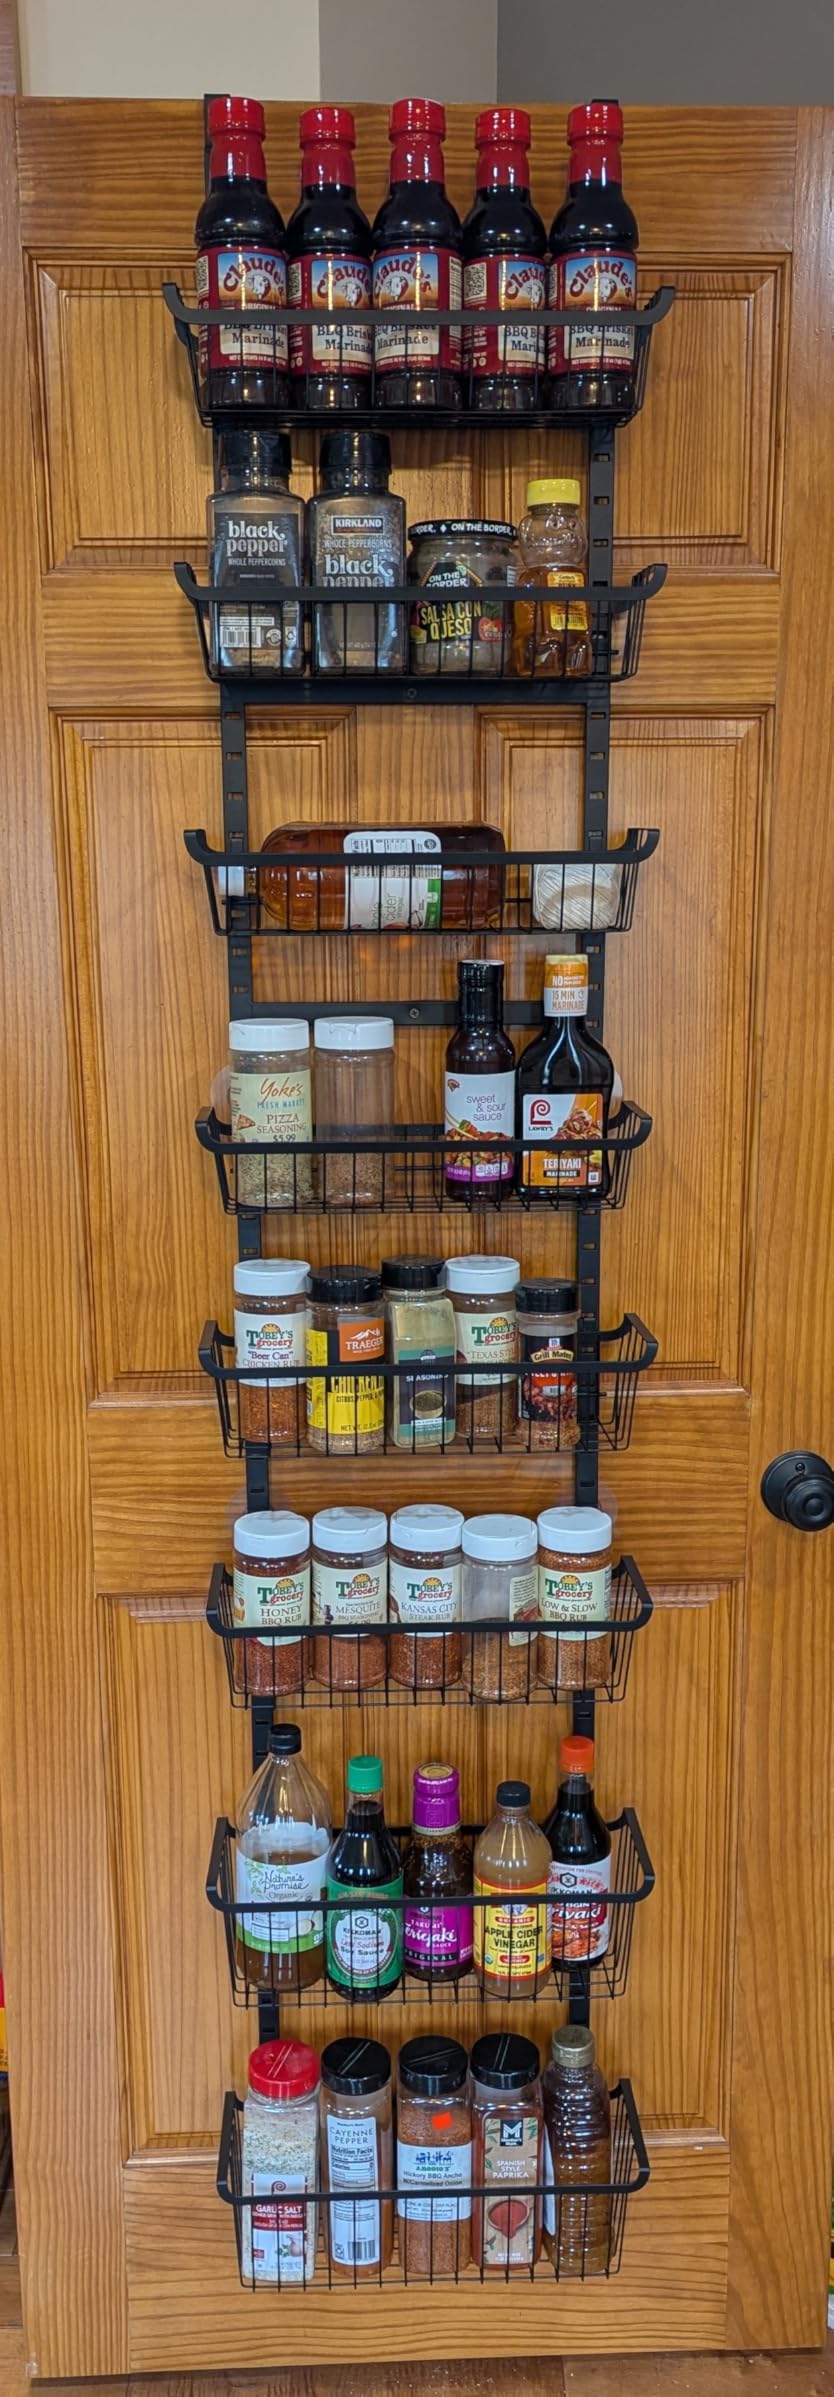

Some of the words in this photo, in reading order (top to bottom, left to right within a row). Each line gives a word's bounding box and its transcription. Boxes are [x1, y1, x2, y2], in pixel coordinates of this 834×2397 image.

[570, 259, 633, 299] Claude's
[335, 518, 382, 528] KIRKLAND
[451, 523, 465, 532] ON
[466, 523, 482, 532] THE
[227, 520, 286, 540] black
[226, 538, 288, 557] pepper
[228, 558, 247, 567] WHOLE
[248, 558, 286, 567] PEPPERCORNS
[324, 554, 394, 577] black
[429, 574, 442, 583] ON
[444, 571, 460, 581] THE
[384, 892, 397, 921] cider
[552, 975, 564, 986] NO
[552, 990, 560, 1000] 15
[560, 990, 575, 1001] MIN
[552, 1001, 585, 1009] MARINADE
[260, 1076, 304, 1104] Yoke's
[256, 1101, 279, 1109] FRESH
[466, 1094, 496, 1104] sweet
[476, 1103, 484, 1113] &
[486, 1102, 507, 1113] sour
[266, 1113, 300, 1125] PIZZA
[472, 1112, 502, 1122] sauce
[256, 1122, 307, 1134] SEASONING
[543, 1158, 582, 1169] TERIYAKI
[246, 1330, 294, 1347] TOBEY'S
[256, 1338, 294, 1350] grocery
[472, 1350, 498, 1360] TEXAS
[534, 1351, 550, 1361] Grill
[552, 1351, 572, 1360] Mates
[257, 1581, 305, 1604] TOBEY'S
[335, 1576, 380, 1597] TOBEY'S
[347, 1585, 380, 1599] grocery
[406, 1582, 453, 1599] TOBEY'S
[545, 1577, 593, 1597] TOBEY'S
[270, 1590, 304, 1606] grocery
[417, 1589, 453, 1602] grocery
[555, 1589, 593, 1600] grocery
[260, 1604, 303, 1617] HONEY
[335, 1602, 381, 1615] MESQUITE
[401, 1602, 437, 1614] KANSAS
[439, 1602, 457, 1613] CITY
[541, 1597, 560, 1610] LOW
[561, 1604, 570, 1612] &
[571, 1602, 598, 1613] SLOW
[261, 1617, 282, 1626] BBQ
[284, 1613, 302, 1624] RUB
[550, 1610, 567, 1621] BBQ
[264, 1869, 305, 1883] Nature's
[261, 1880, 310, 1893] Promise
[268, 1891, 298, 1899] Organic
[343, 1927, 382, 1936] KIKOMAN
[485, 1925, 514, 1939] APPLE
[517, 1925, 544, 1939] CIDER
[493, 1938, 536, 1949] VINEGAR
[329, 2127, 374, 2138] CAYENNE
[334, 2135, 369, 2145] PEPPER
[403, 2170, 427, 2180] Hickory
[492, 2171, 529, 2179] PAPRIKA
[256, 2204, 283, 2214] GARLC
[284, 2205, 303, 2214] SALT
